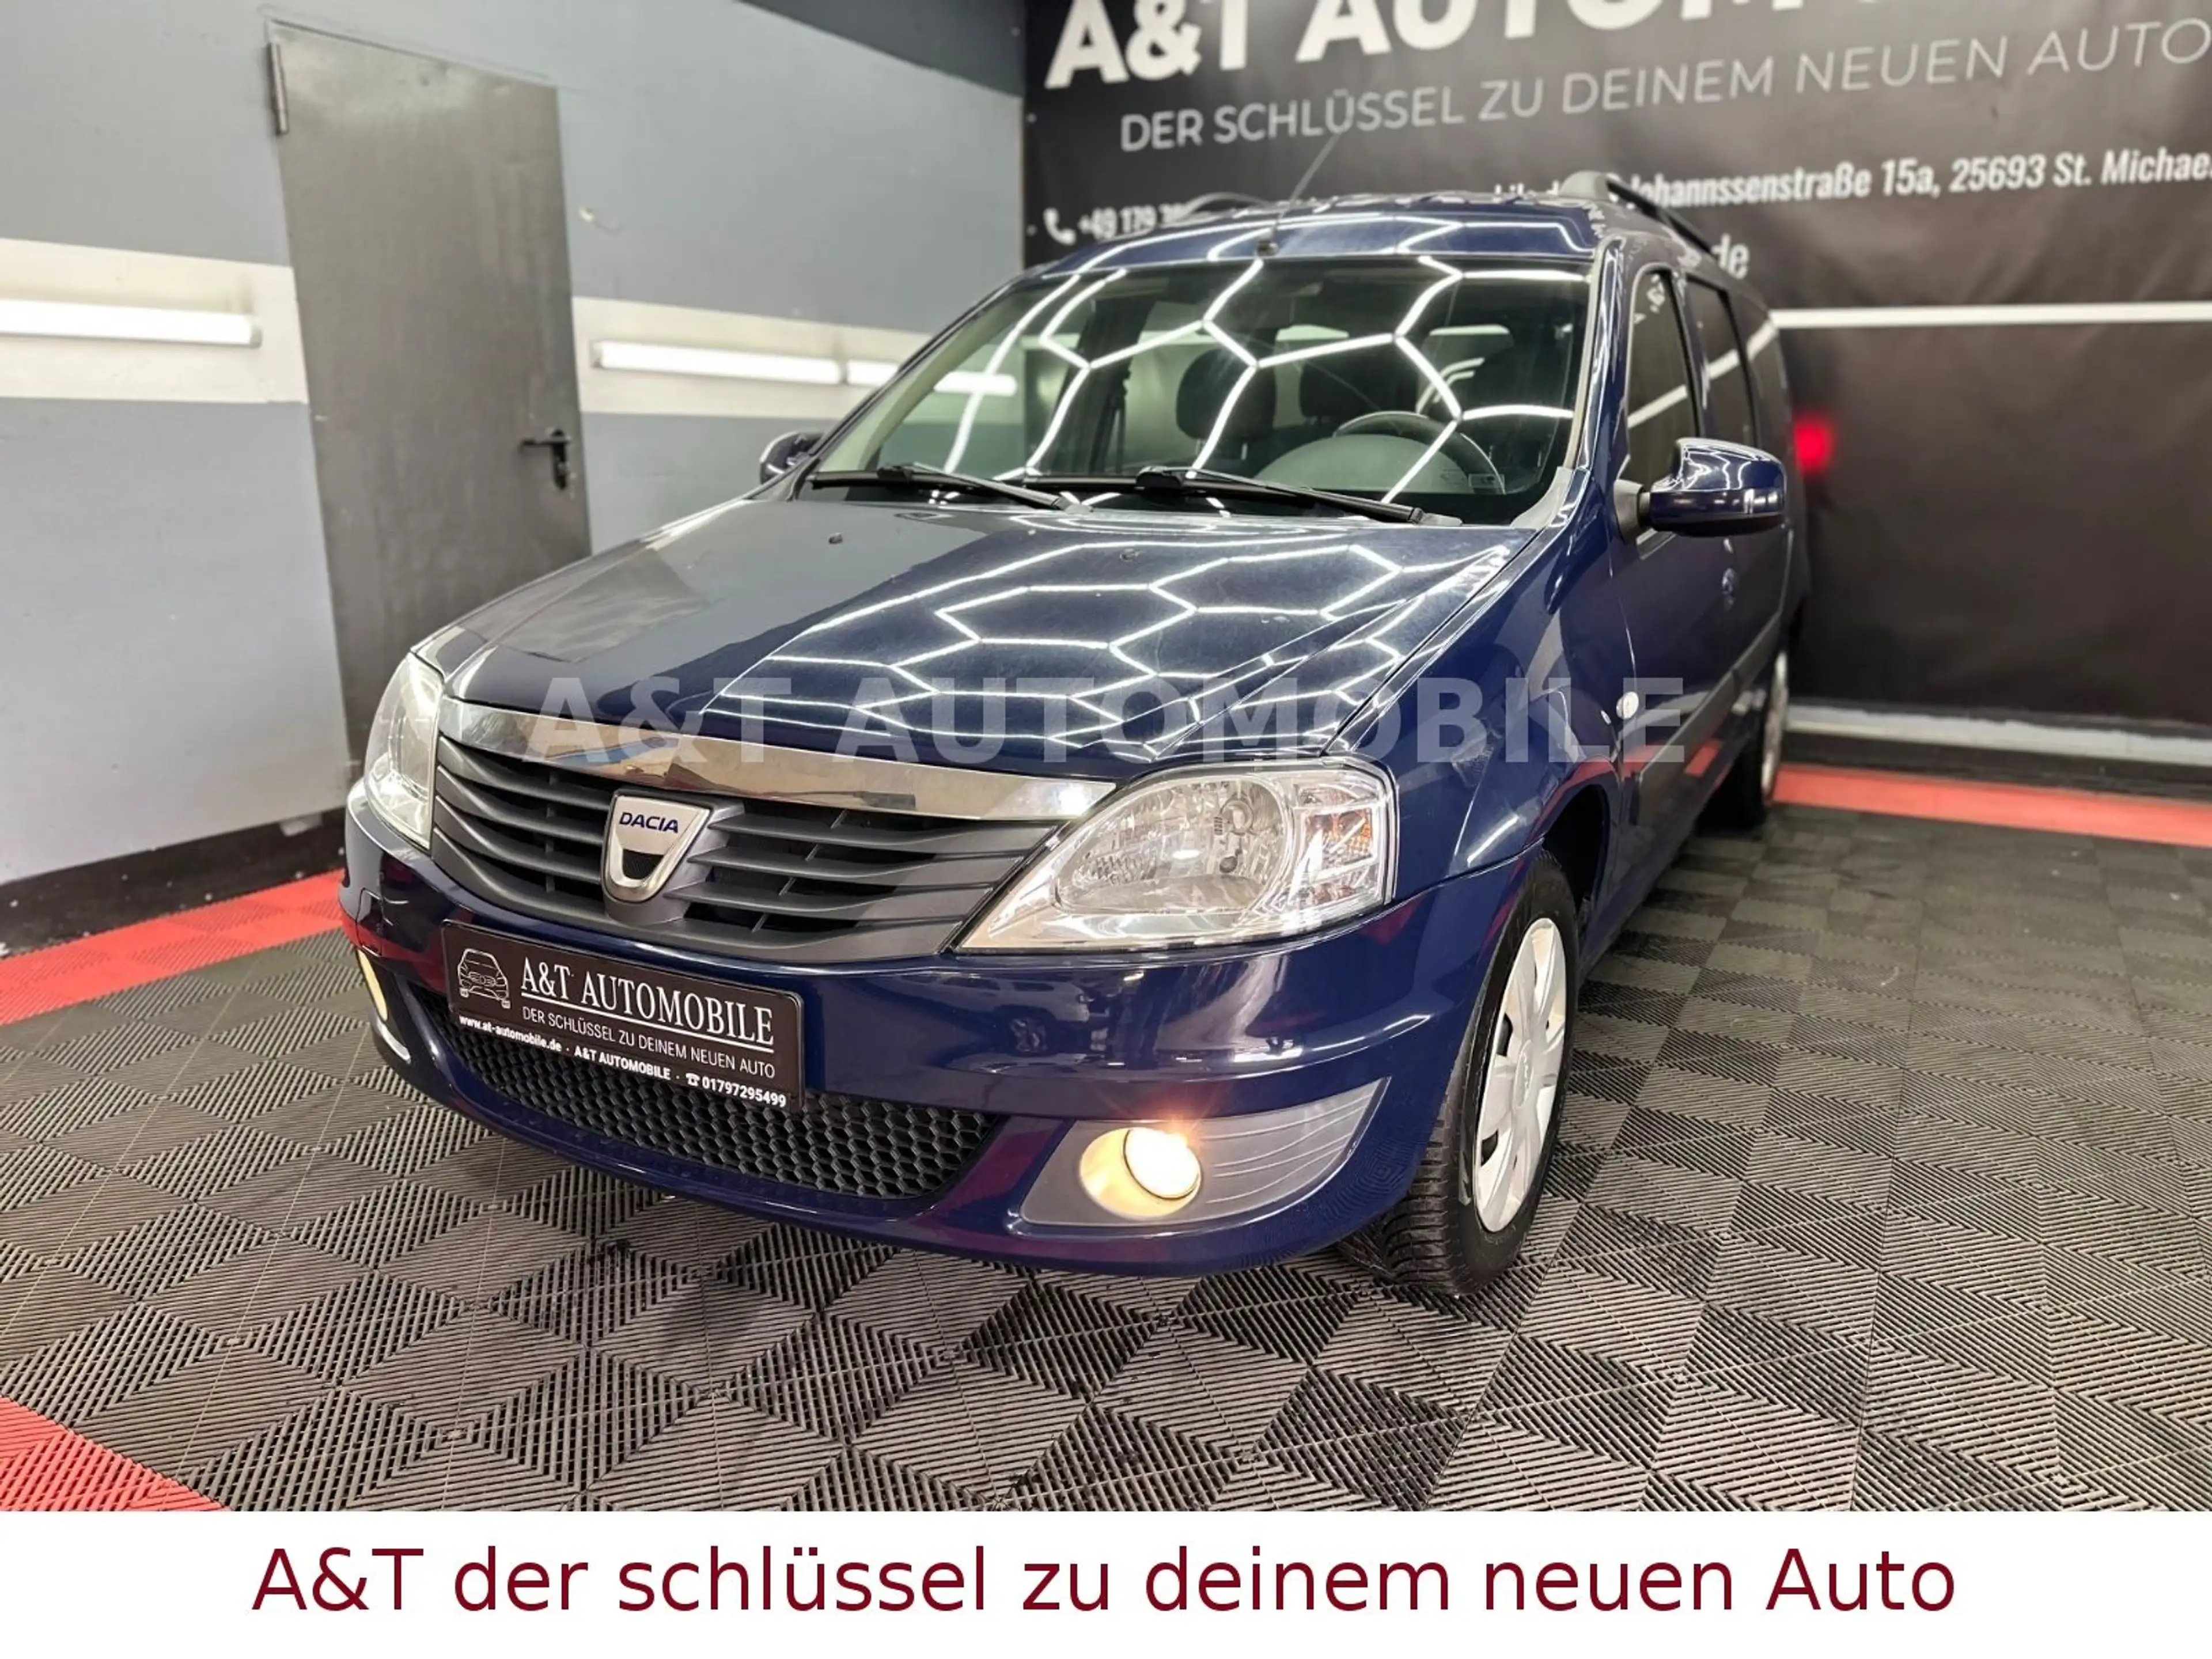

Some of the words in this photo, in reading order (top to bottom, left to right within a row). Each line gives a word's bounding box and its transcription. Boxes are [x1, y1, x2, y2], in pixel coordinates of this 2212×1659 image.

[1120, 108, 1204, 151] DER
[1213, 86, 1465, 144] SCHLÜSSEL
[1477, 78, 1544, 122] ZU
[1562, 55, 1774, 114] DEINEM
[1796, 36, 2008, 94] NEUEN
[2027, 17, 2211, 77] AUTO
[1882, 159, 1941, 199] 15a,
[1949, 153, 2048, 194] 25693
[2052, 150, 2093, 188] St.
[2100, 146, 2212, 185] Michae
[619, 812, 679, 834] DACIA
[521, 956, 570, 1000] A&T
[581, 971, 775, 1046] AUTOMOBILE
[459, 1015, 562, 1052] www.at-automobile.de
[574, 1046, 596, 1063] A&T
[599, 1052, 671, 1081] AUTOMOBILE
[702, 1076, 786, 1108] 01797295499
[522, 1006, 545, 1024] DER
[548, 1012, 615, 1043] SCHLÜSSEL
[618, 1029, 634, 1047] ZU
[638, 1035, 687, 1059] DEINEM
[691, 1045, 735, 1070] NEUEN
[739, 1057, 776, 1080] AUTO
